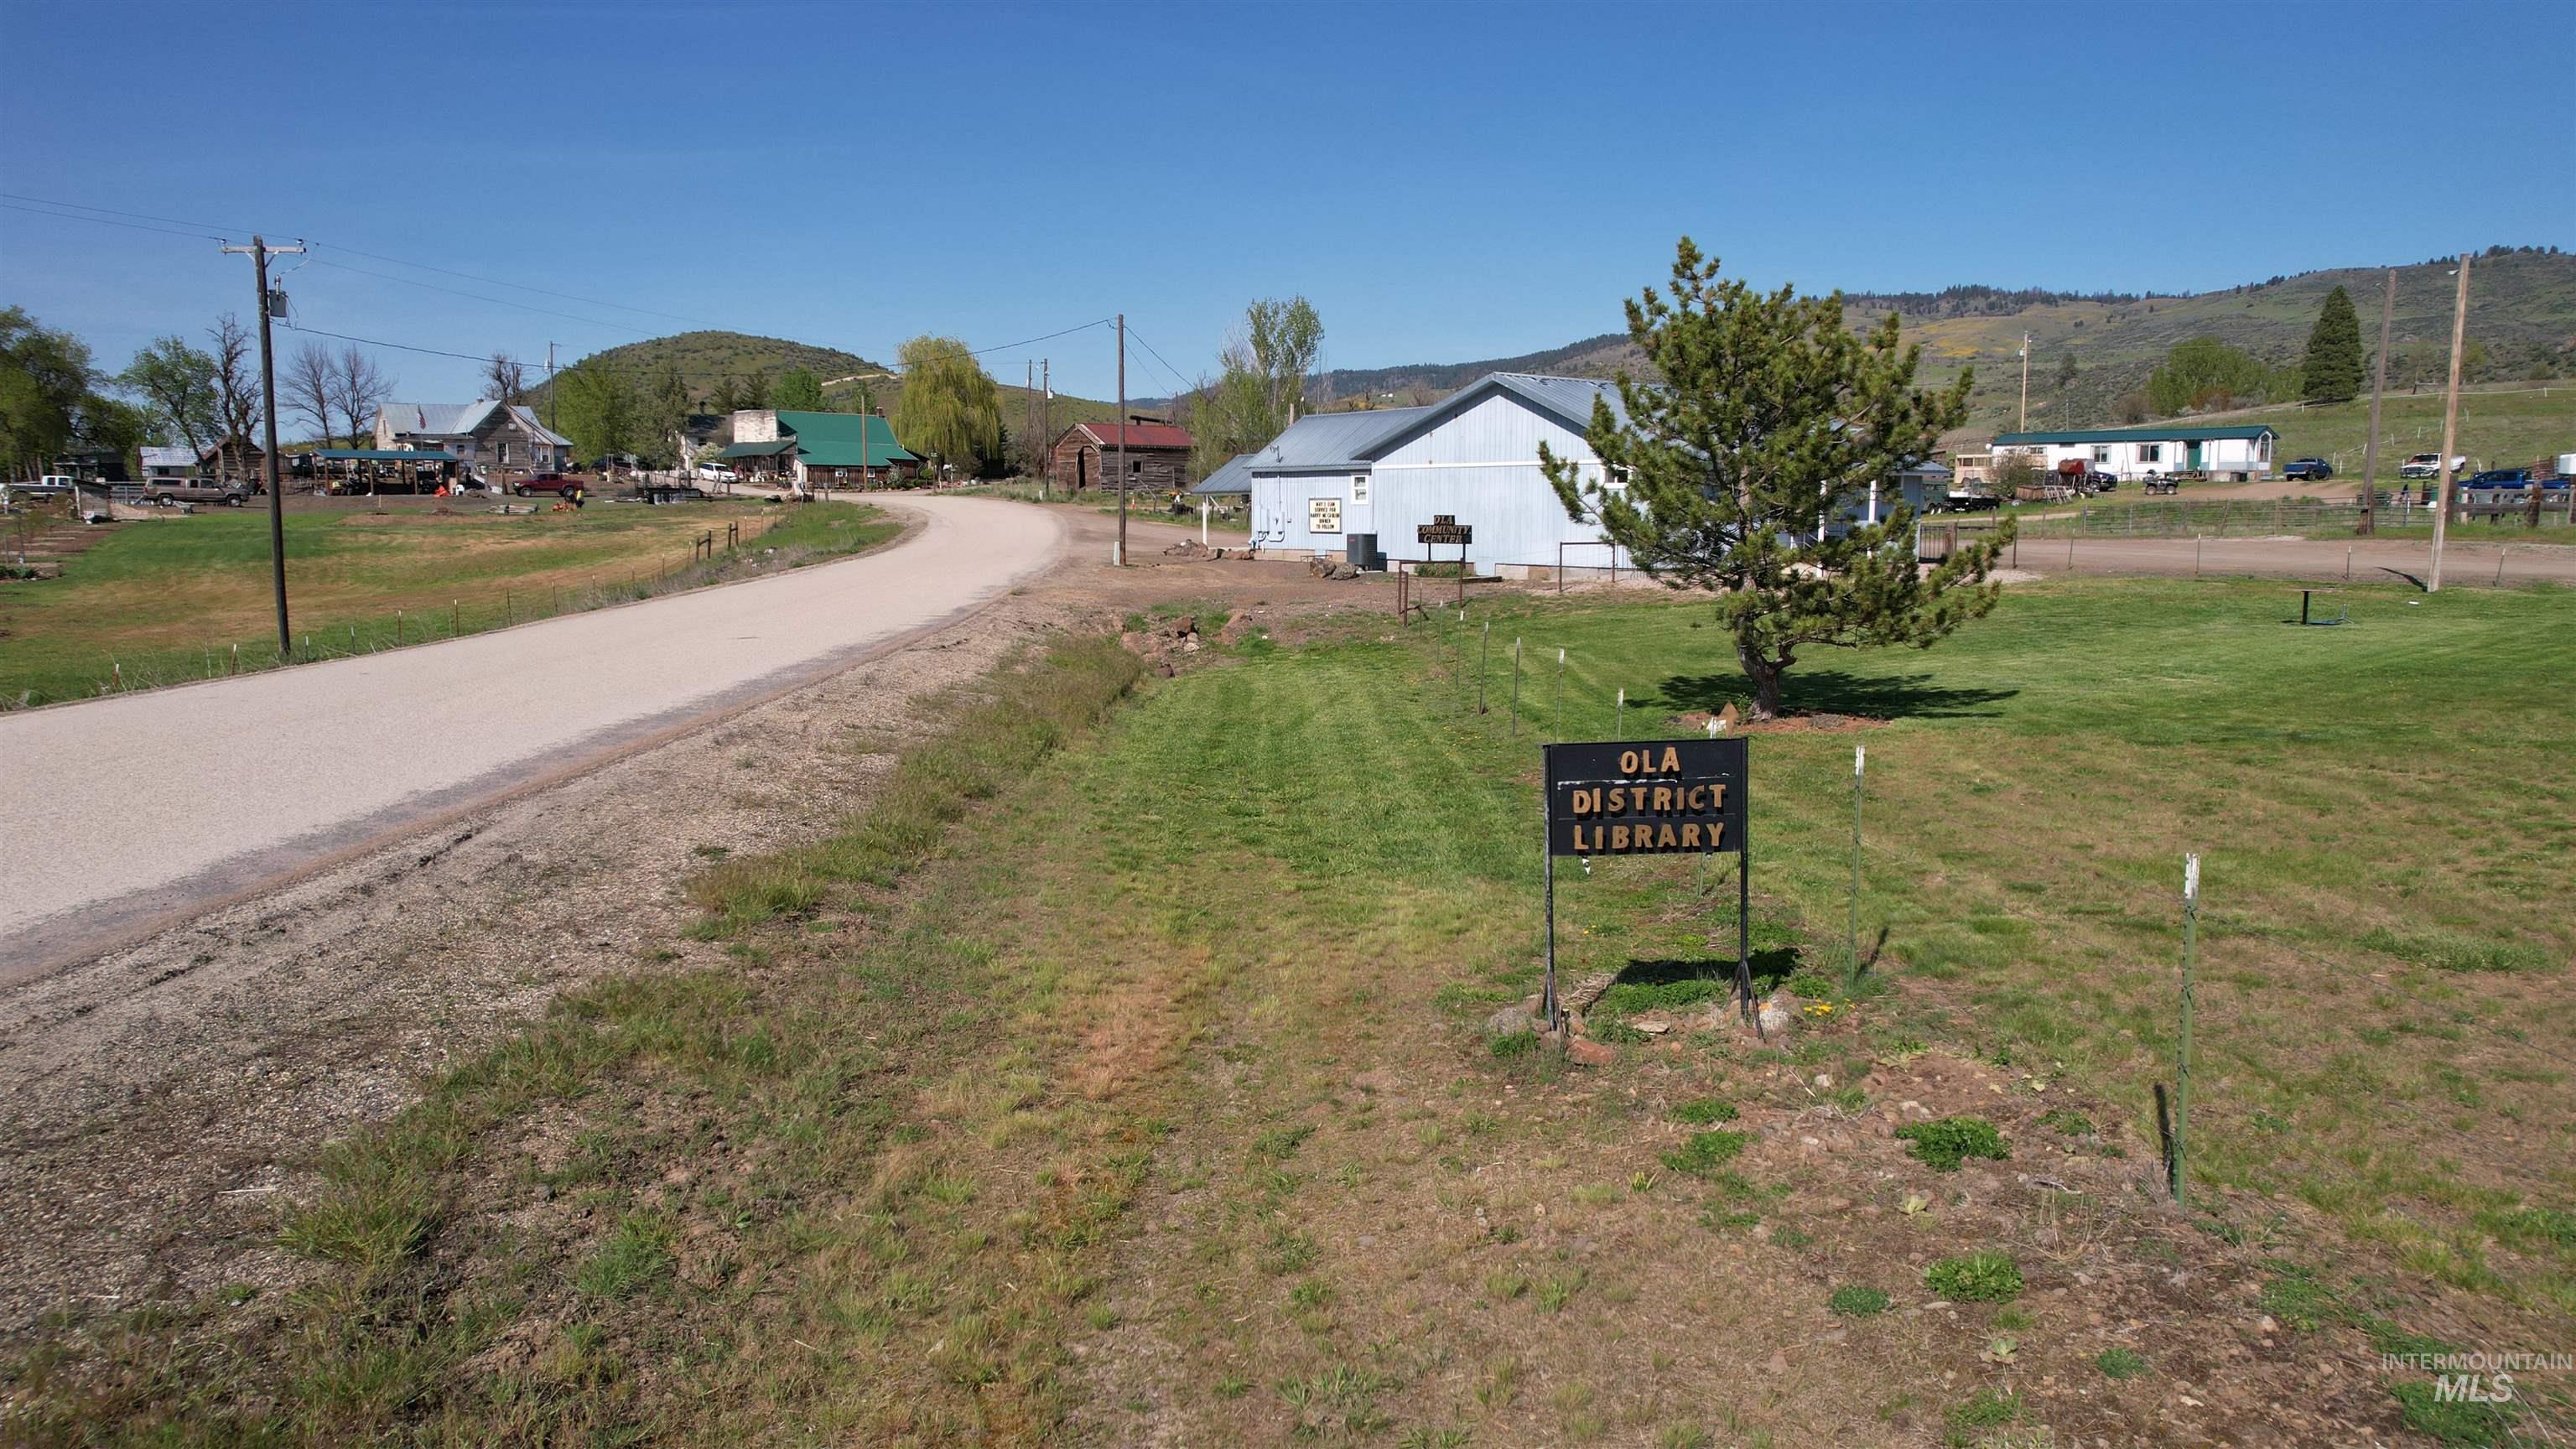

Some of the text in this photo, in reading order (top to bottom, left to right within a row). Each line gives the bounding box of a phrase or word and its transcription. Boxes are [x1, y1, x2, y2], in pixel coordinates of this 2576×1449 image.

[1434, 516, 1453, 525] OLA
[1423, 533, 1463, 543] CENTER
[1620, 746, 1680, 774] OLA
[1572, 784, 1727, 813] DISTRICT
[1573, 822, 1725, 850] LIBRARY
